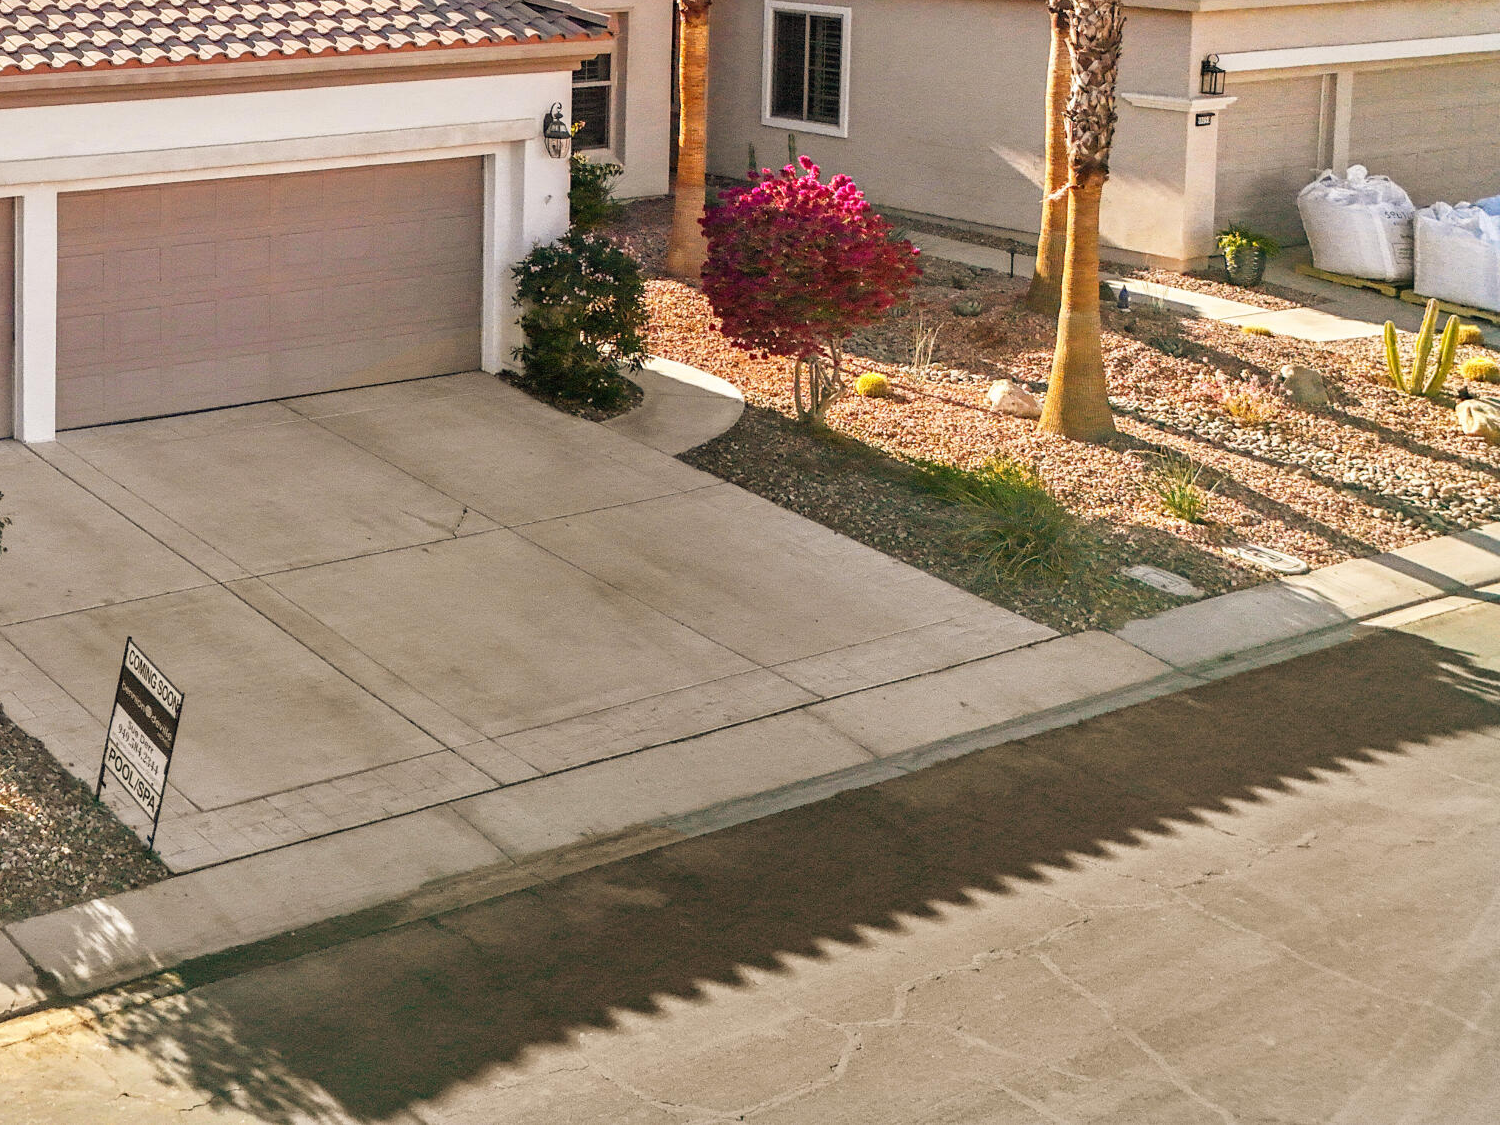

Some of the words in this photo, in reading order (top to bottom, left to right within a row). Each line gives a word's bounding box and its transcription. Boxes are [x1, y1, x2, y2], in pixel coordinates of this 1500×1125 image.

[129, 649, 157, 690] COMING
[157, 680, 180, 711] SOON
[128, 721, 139, 738] Sue
[108, 748, 155, 814] POOL/SPA
